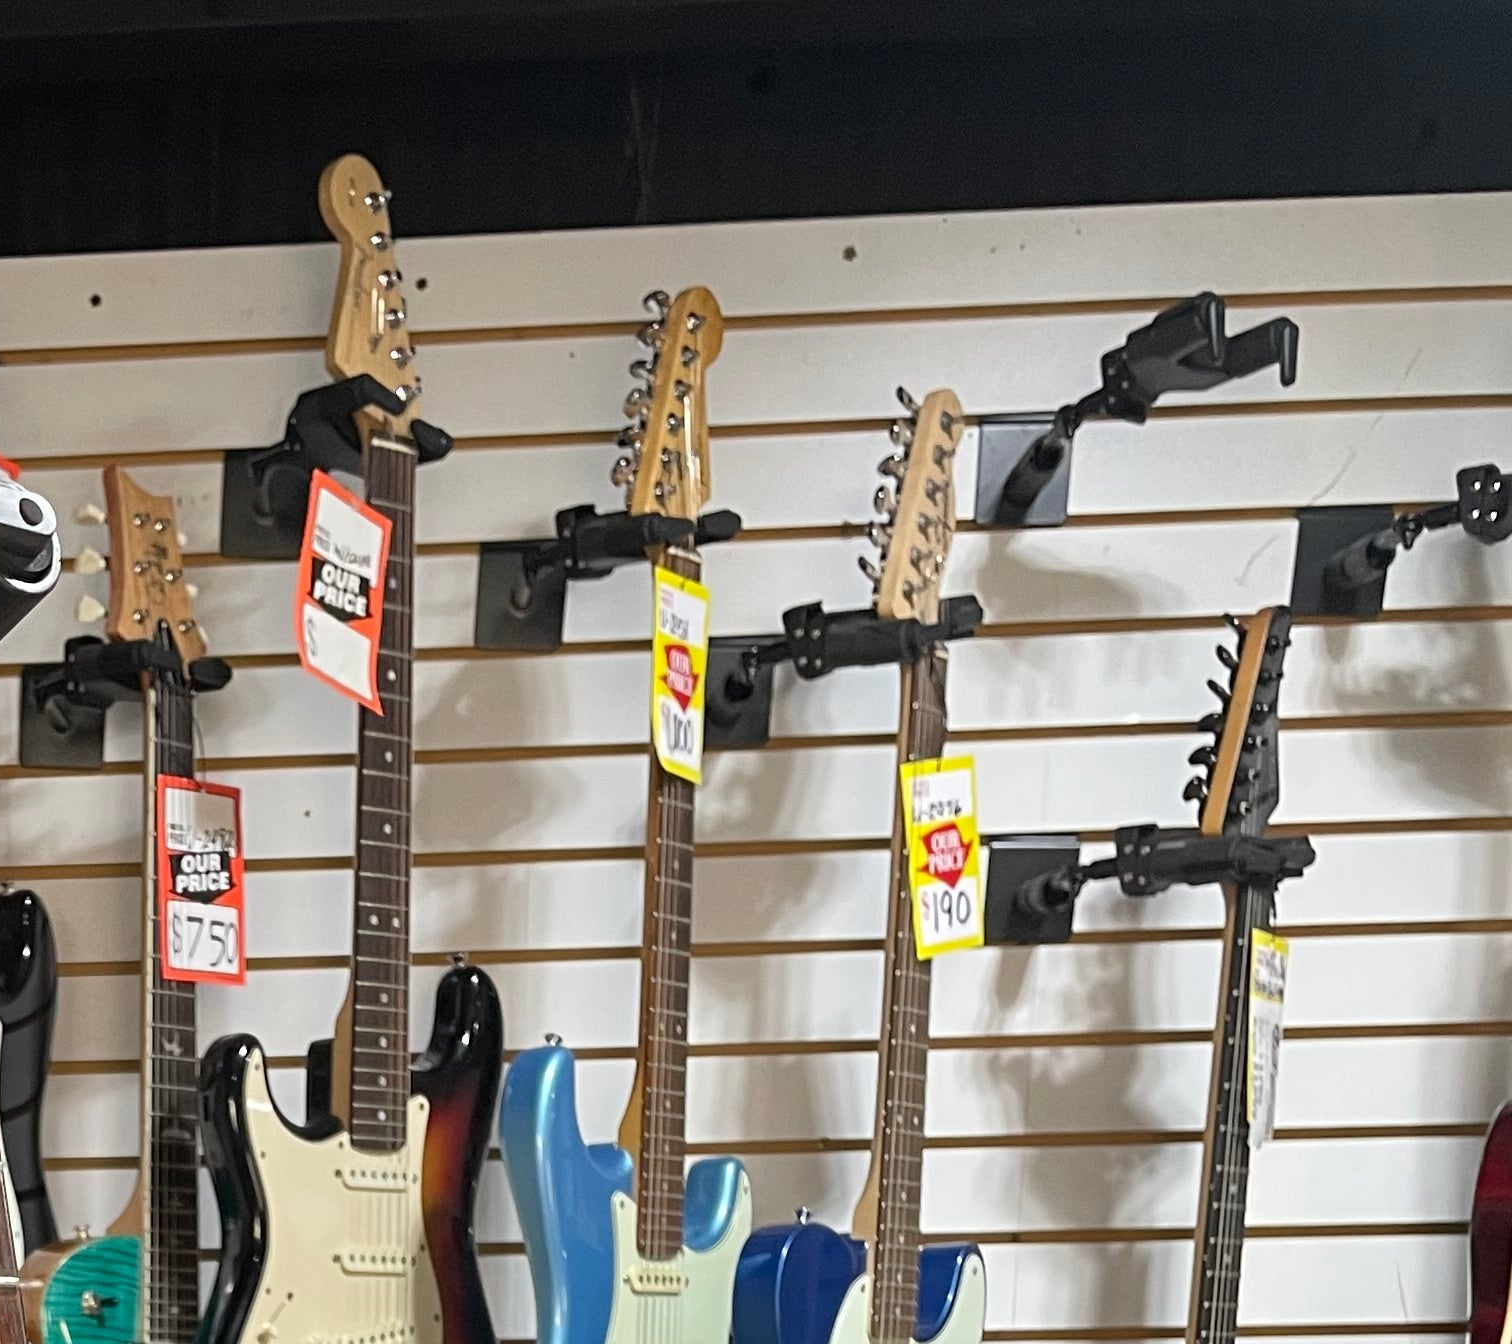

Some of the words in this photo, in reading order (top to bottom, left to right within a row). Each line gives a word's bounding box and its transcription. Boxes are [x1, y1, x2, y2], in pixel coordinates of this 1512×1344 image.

[320, 563, 361, 593] OUR
[313, 578, 367, 618] PRICE
[180, 853, 222, 874] OUR
[174, 871, 231, 894] PRICE
[172, 913, 238, 968] $750
